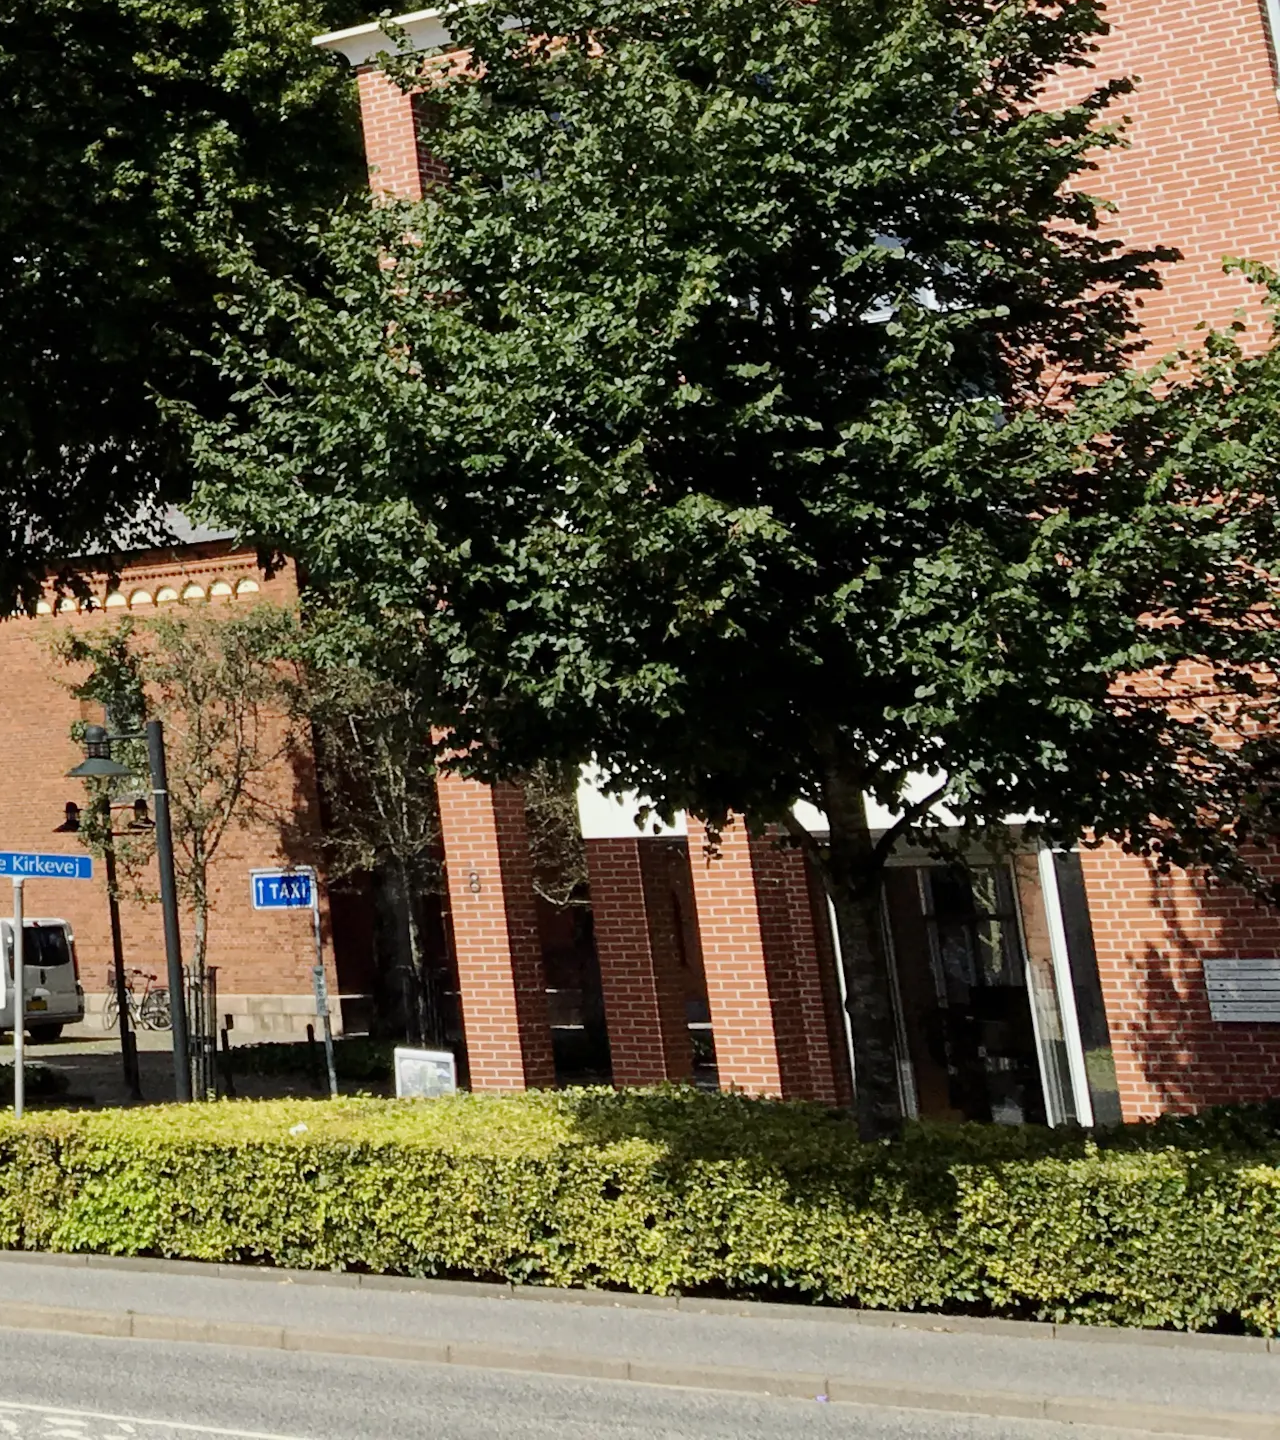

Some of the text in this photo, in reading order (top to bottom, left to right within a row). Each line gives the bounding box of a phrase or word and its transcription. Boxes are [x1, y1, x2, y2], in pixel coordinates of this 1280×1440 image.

[12, 855, 79, 878] Kirkevej
[269, 882, 306, 899] TAXI
[470, 872, 481, 893] 8
